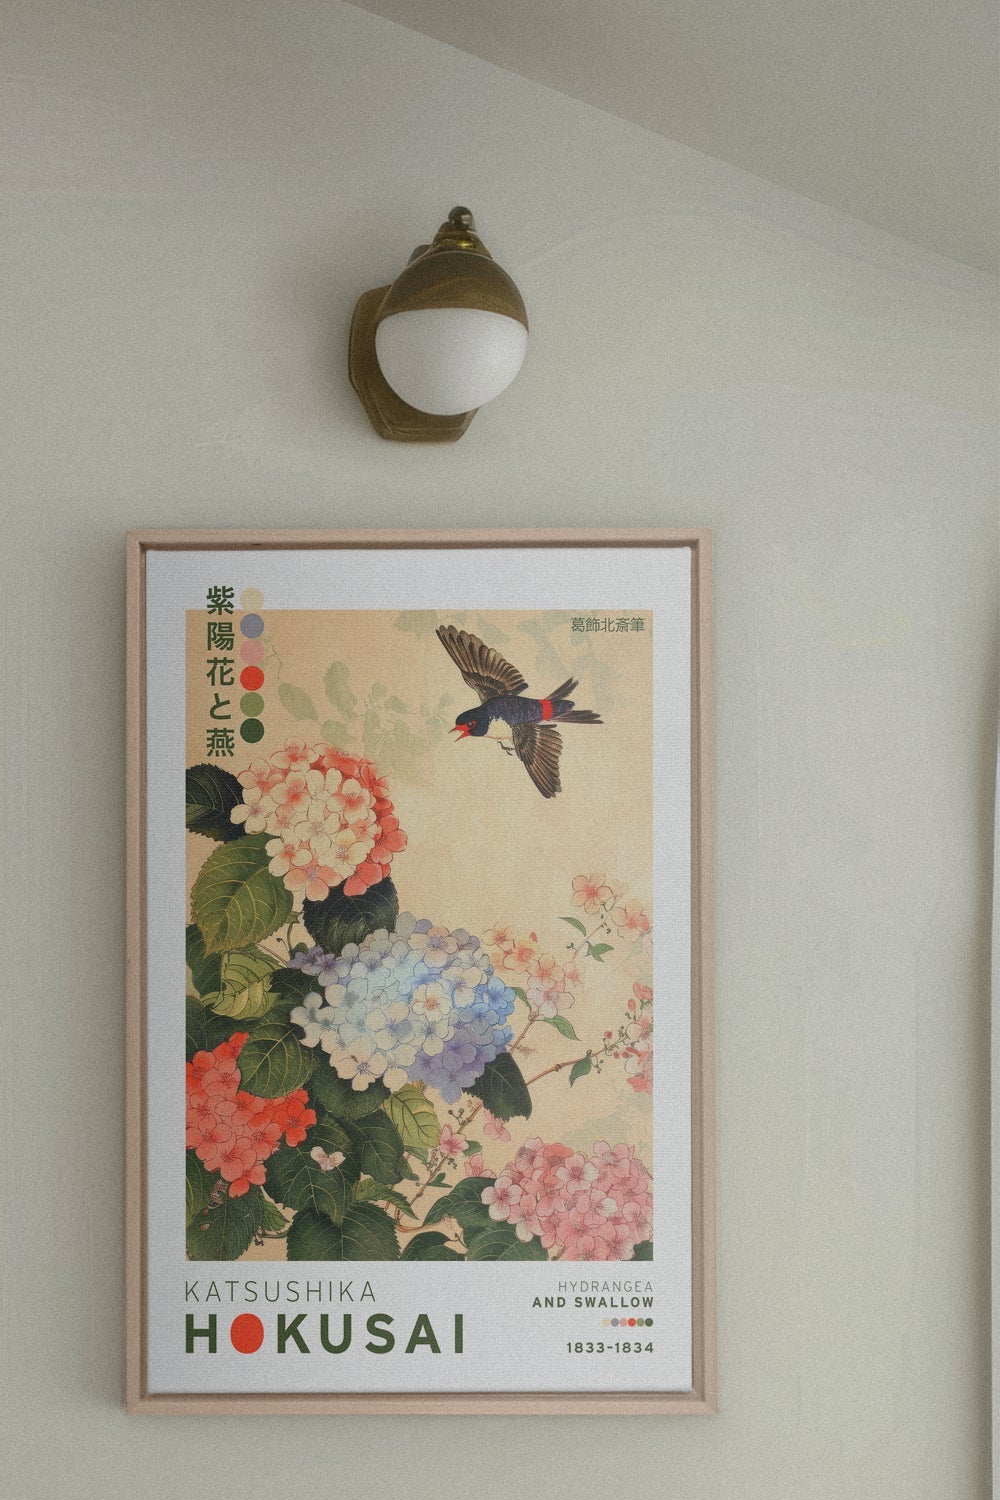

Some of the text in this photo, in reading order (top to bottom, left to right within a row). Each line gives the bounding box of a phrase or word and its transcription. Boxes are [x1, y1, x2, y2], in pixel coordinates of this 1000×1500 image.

[206, 585, 235, 757] 紫陽花と燕
[185, 1280, 376, 1302] KATSUSHIKA
[558, 1281, 653, 1292] HYDRANGEA
[532, 1296, 654, 1308] AND SWALLOW
[185, 1313, 464, 1354] HOKUSAI
[567, 1342, 654, 1353] 1833-1834
